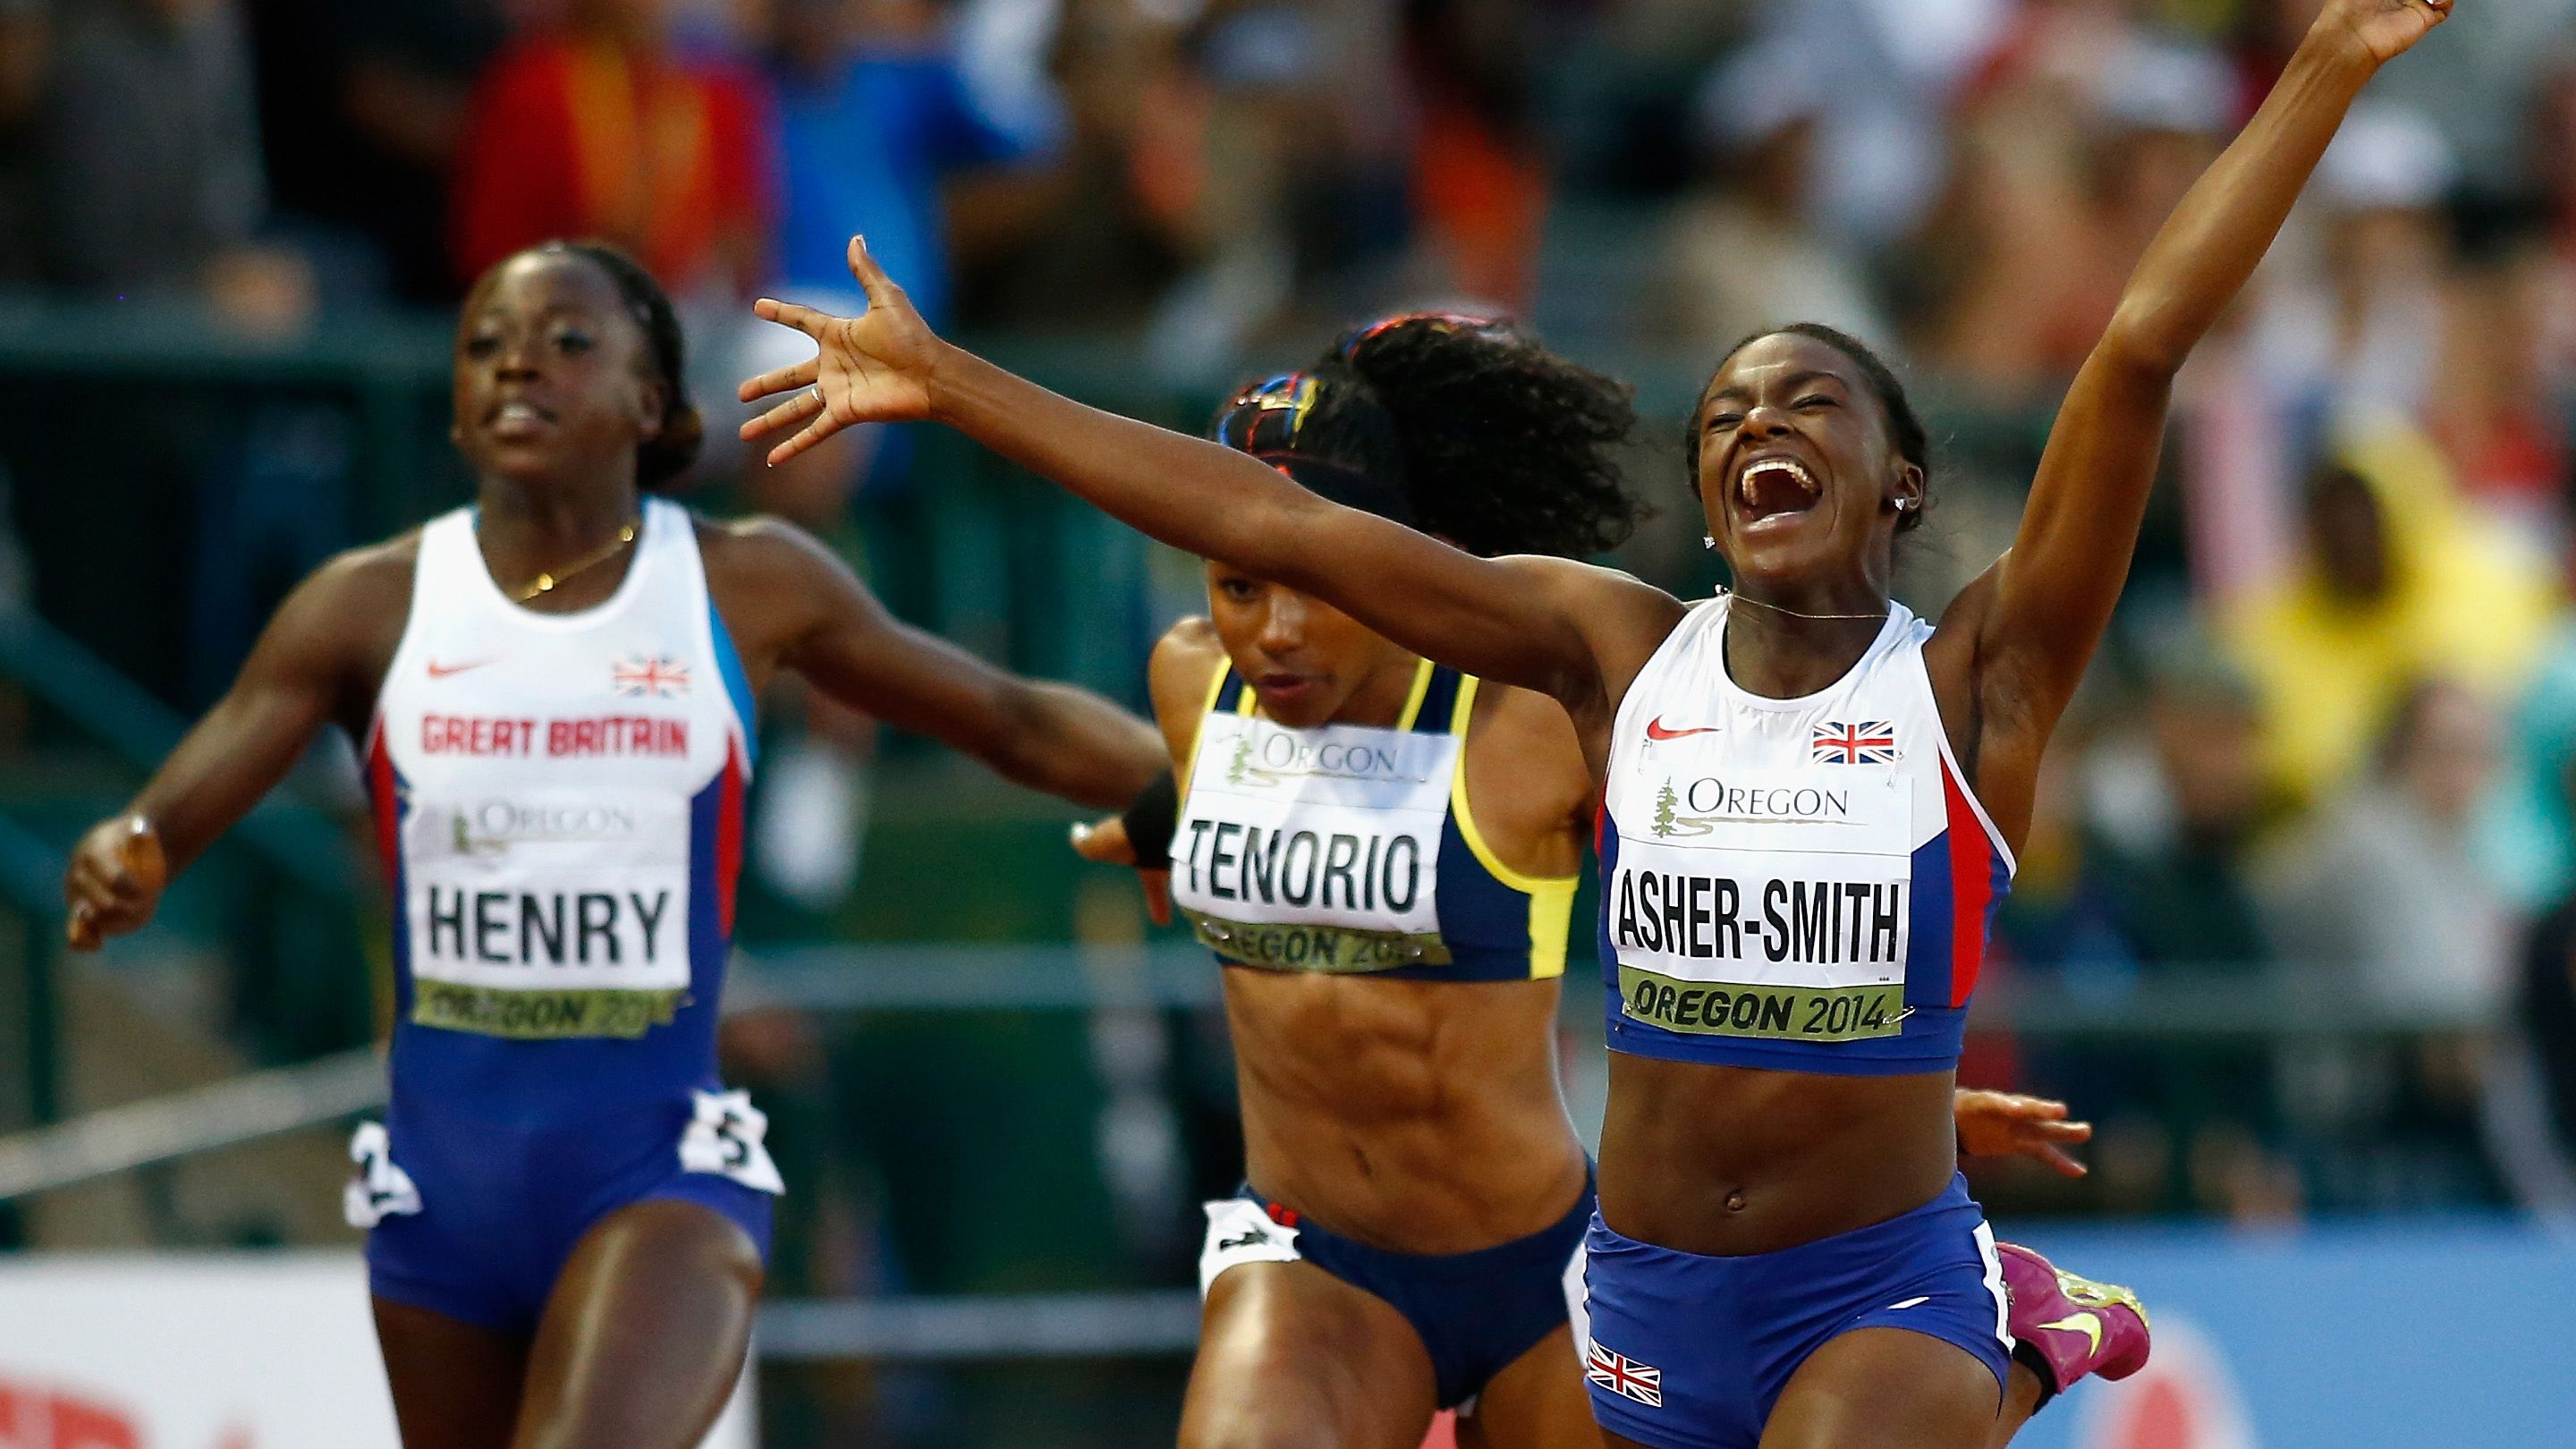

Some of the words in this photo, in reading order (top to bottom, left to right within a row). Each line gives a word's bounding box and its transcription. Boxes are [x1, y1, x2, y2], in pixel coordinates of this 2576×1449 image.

[421, 715, 535, 756] GREAT
[547, 716, 690, 758] BRITAIN
[1688, 776, 1848, 817] OREGON
[1189, 818, 1419, 914] TENORIO
[427, 884, 669, 966] HENRY
[1618, 869, 1899, 964] ASHER-SMITH
[1633, 979, 1795, 1031] OREGON
[1802, 994, 1886, 1034] 2014
